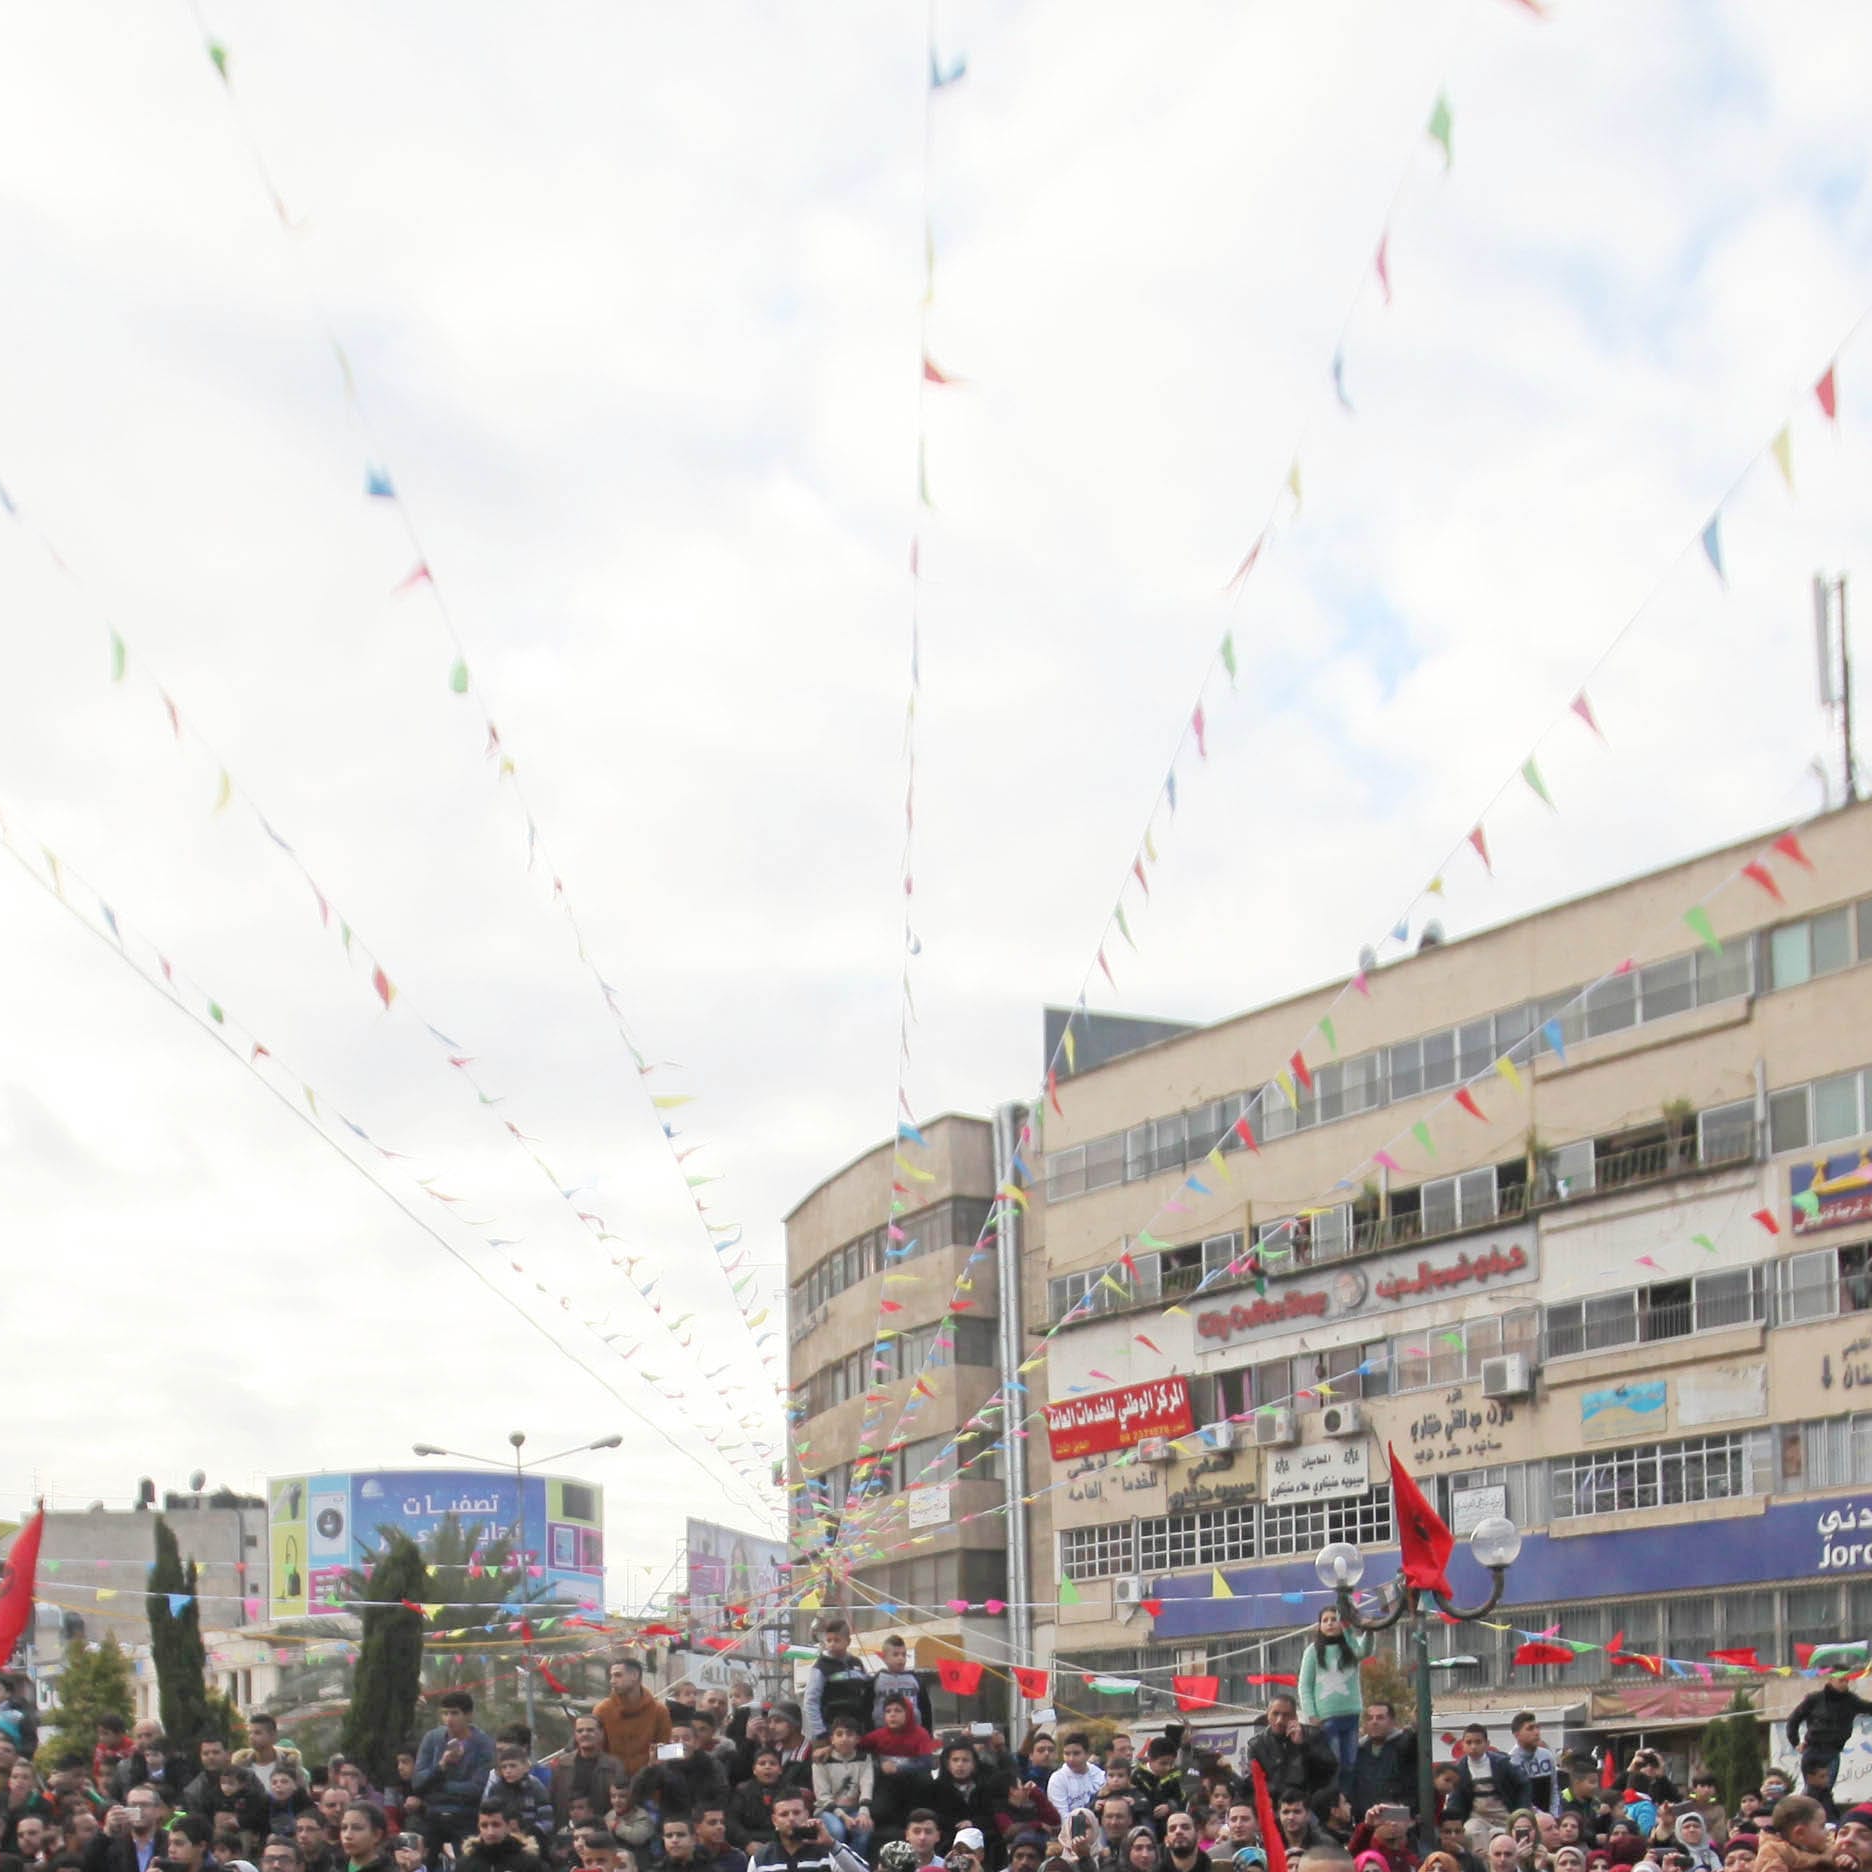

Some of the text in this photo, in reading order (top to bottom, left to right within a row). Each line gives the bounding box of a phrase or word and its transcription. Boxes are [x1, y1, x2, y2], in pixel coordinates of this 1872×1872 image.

[1077, 1396, 1116, 1427] للخدمات
[1118, 1390, 1153, 1431] الوطني
[1156, 1382, 1185, 1415] المركز
[403, 1494, 500, 1515] تصفيات
